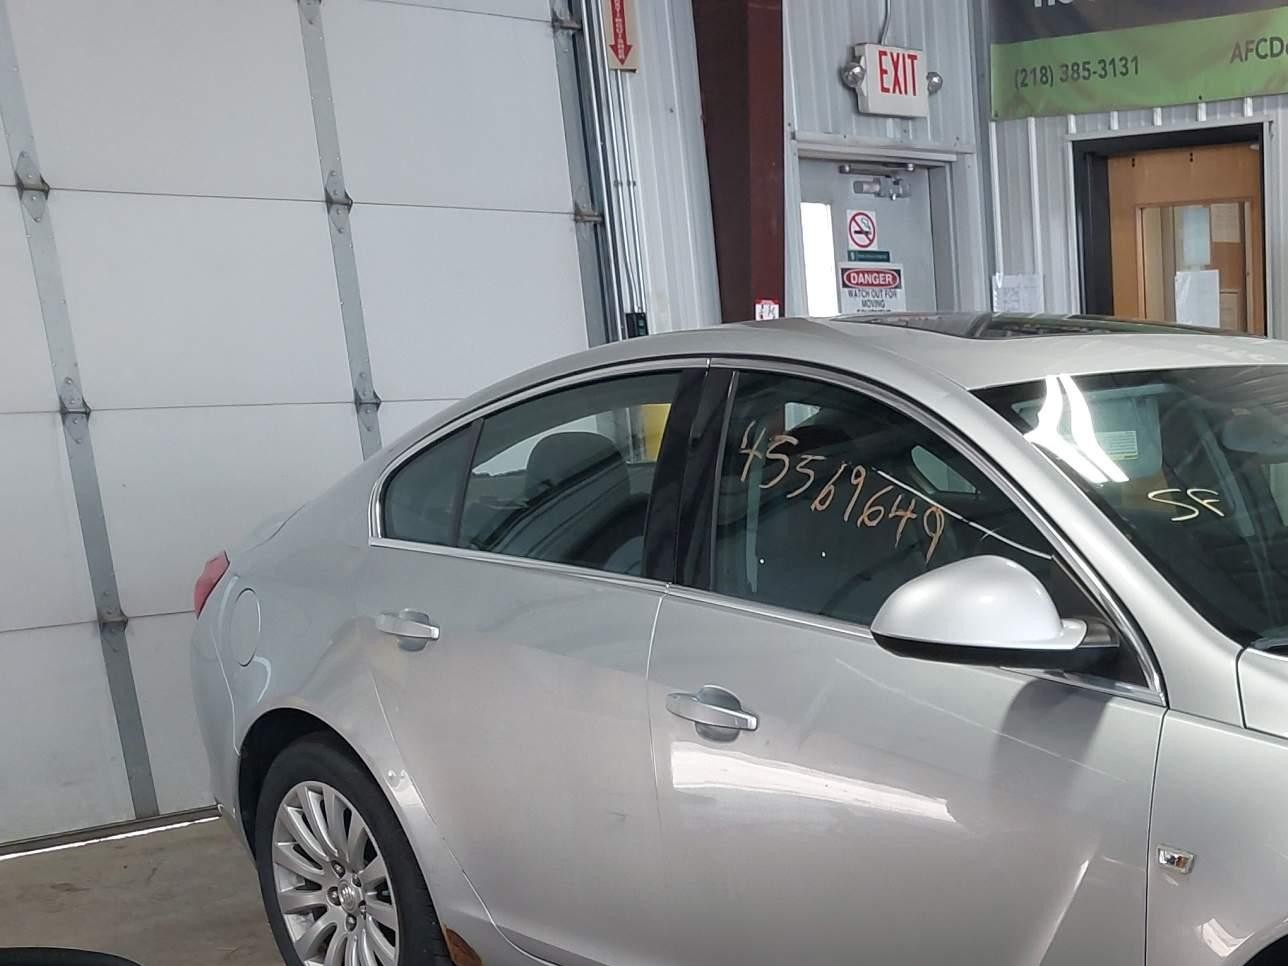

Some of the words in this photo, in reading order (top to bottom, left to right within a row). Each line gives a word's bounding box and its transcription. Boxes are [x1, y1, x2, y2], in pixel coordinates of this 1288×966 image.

[878, 50, 918, 96] EXIT
[1014, 65, 1054, 89] (218)
[1060, 56, 1139, 82] 385-3131
[850, 272, 893, 284] DANGER
[848, 289, 870, 298] WATCH
[871, 289, 883, 298] OUT
[885, 290, 897, 298] FOR
[861, 299, 885, 308] MOVING
[739, 420, 945, 564] 45569649
